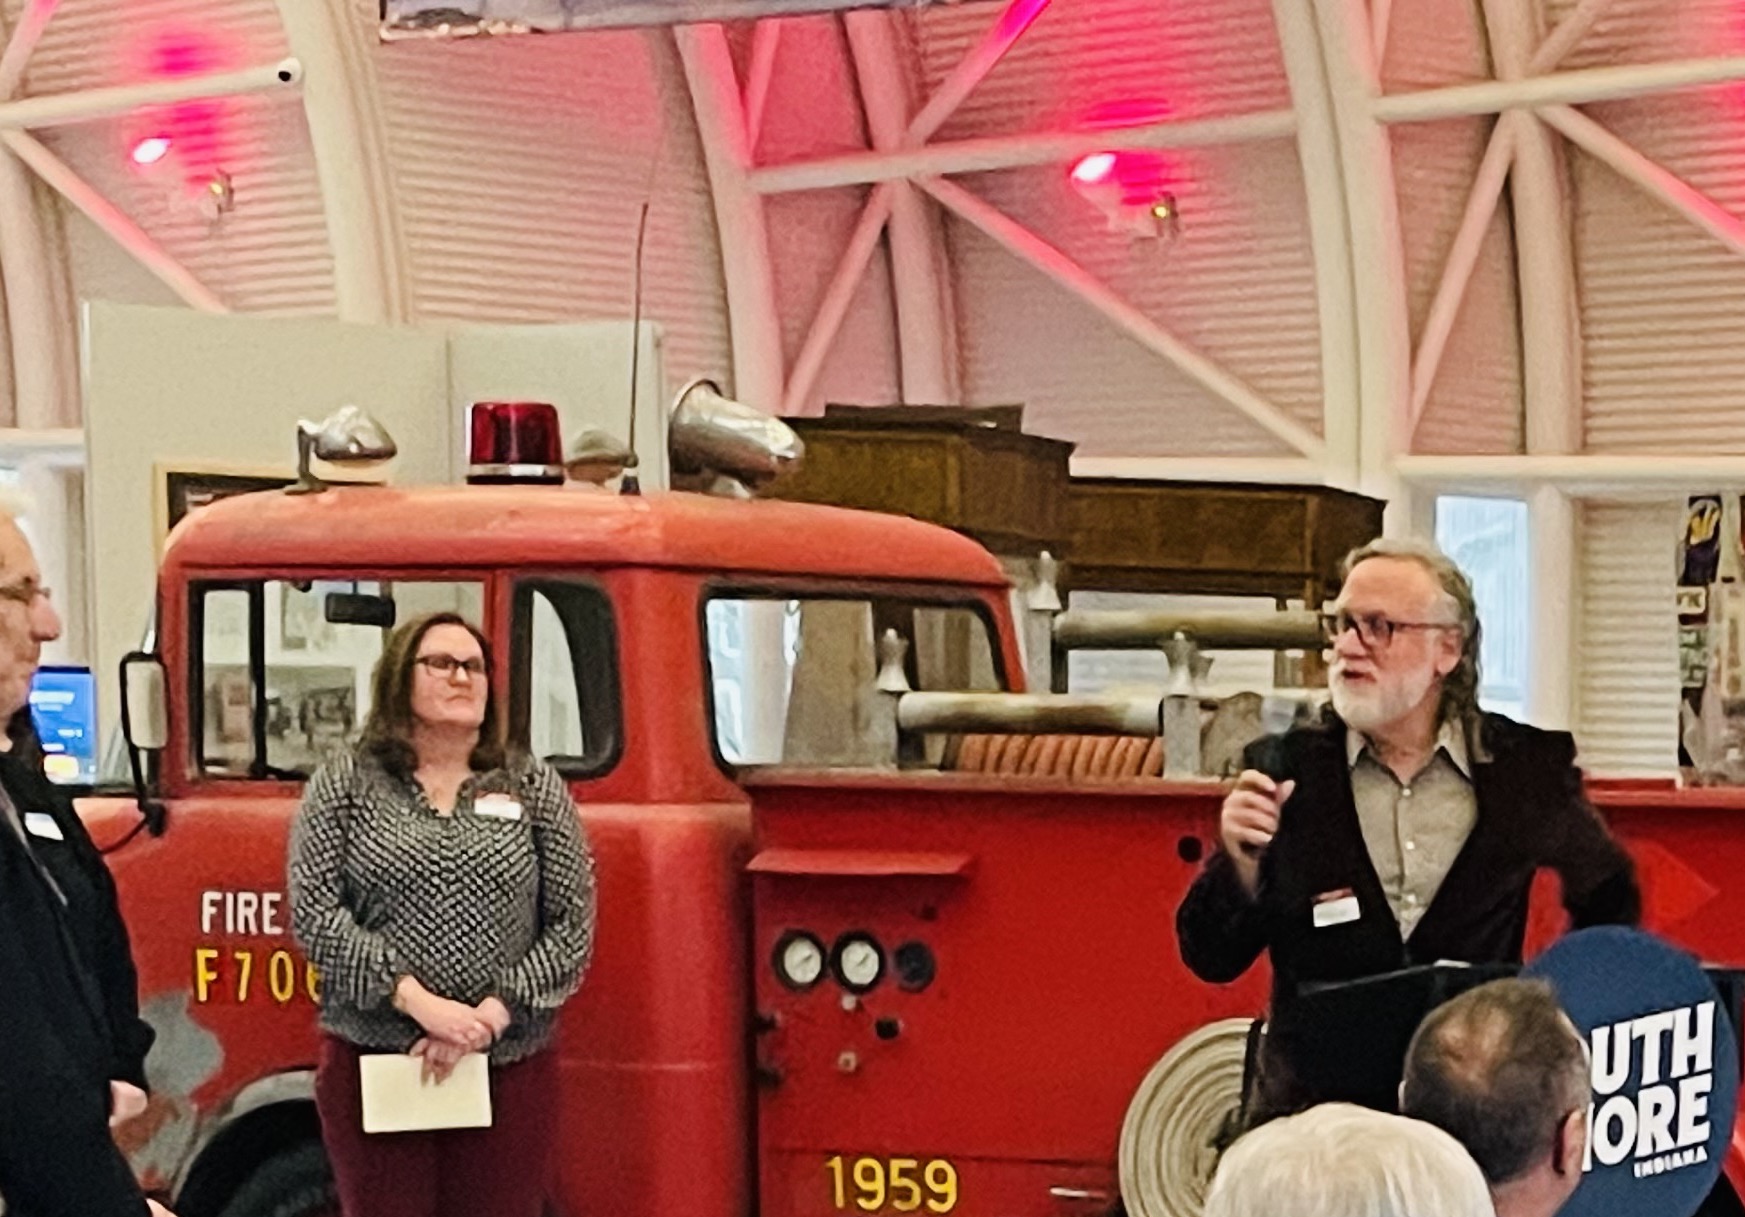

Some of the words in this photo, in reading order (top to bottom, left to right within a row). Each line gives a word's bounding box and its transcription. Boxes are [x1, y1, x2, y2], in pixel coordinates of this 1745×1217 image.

[202, 891, 283, 935] FIRE
[1591, 1001, 1715, 1094] UTH
[1582, 1073, 1712, 1172] ORE
[826, 1156, 957, 1213] 1959
[1634, 1146, 1708, 1178] INDIANA
